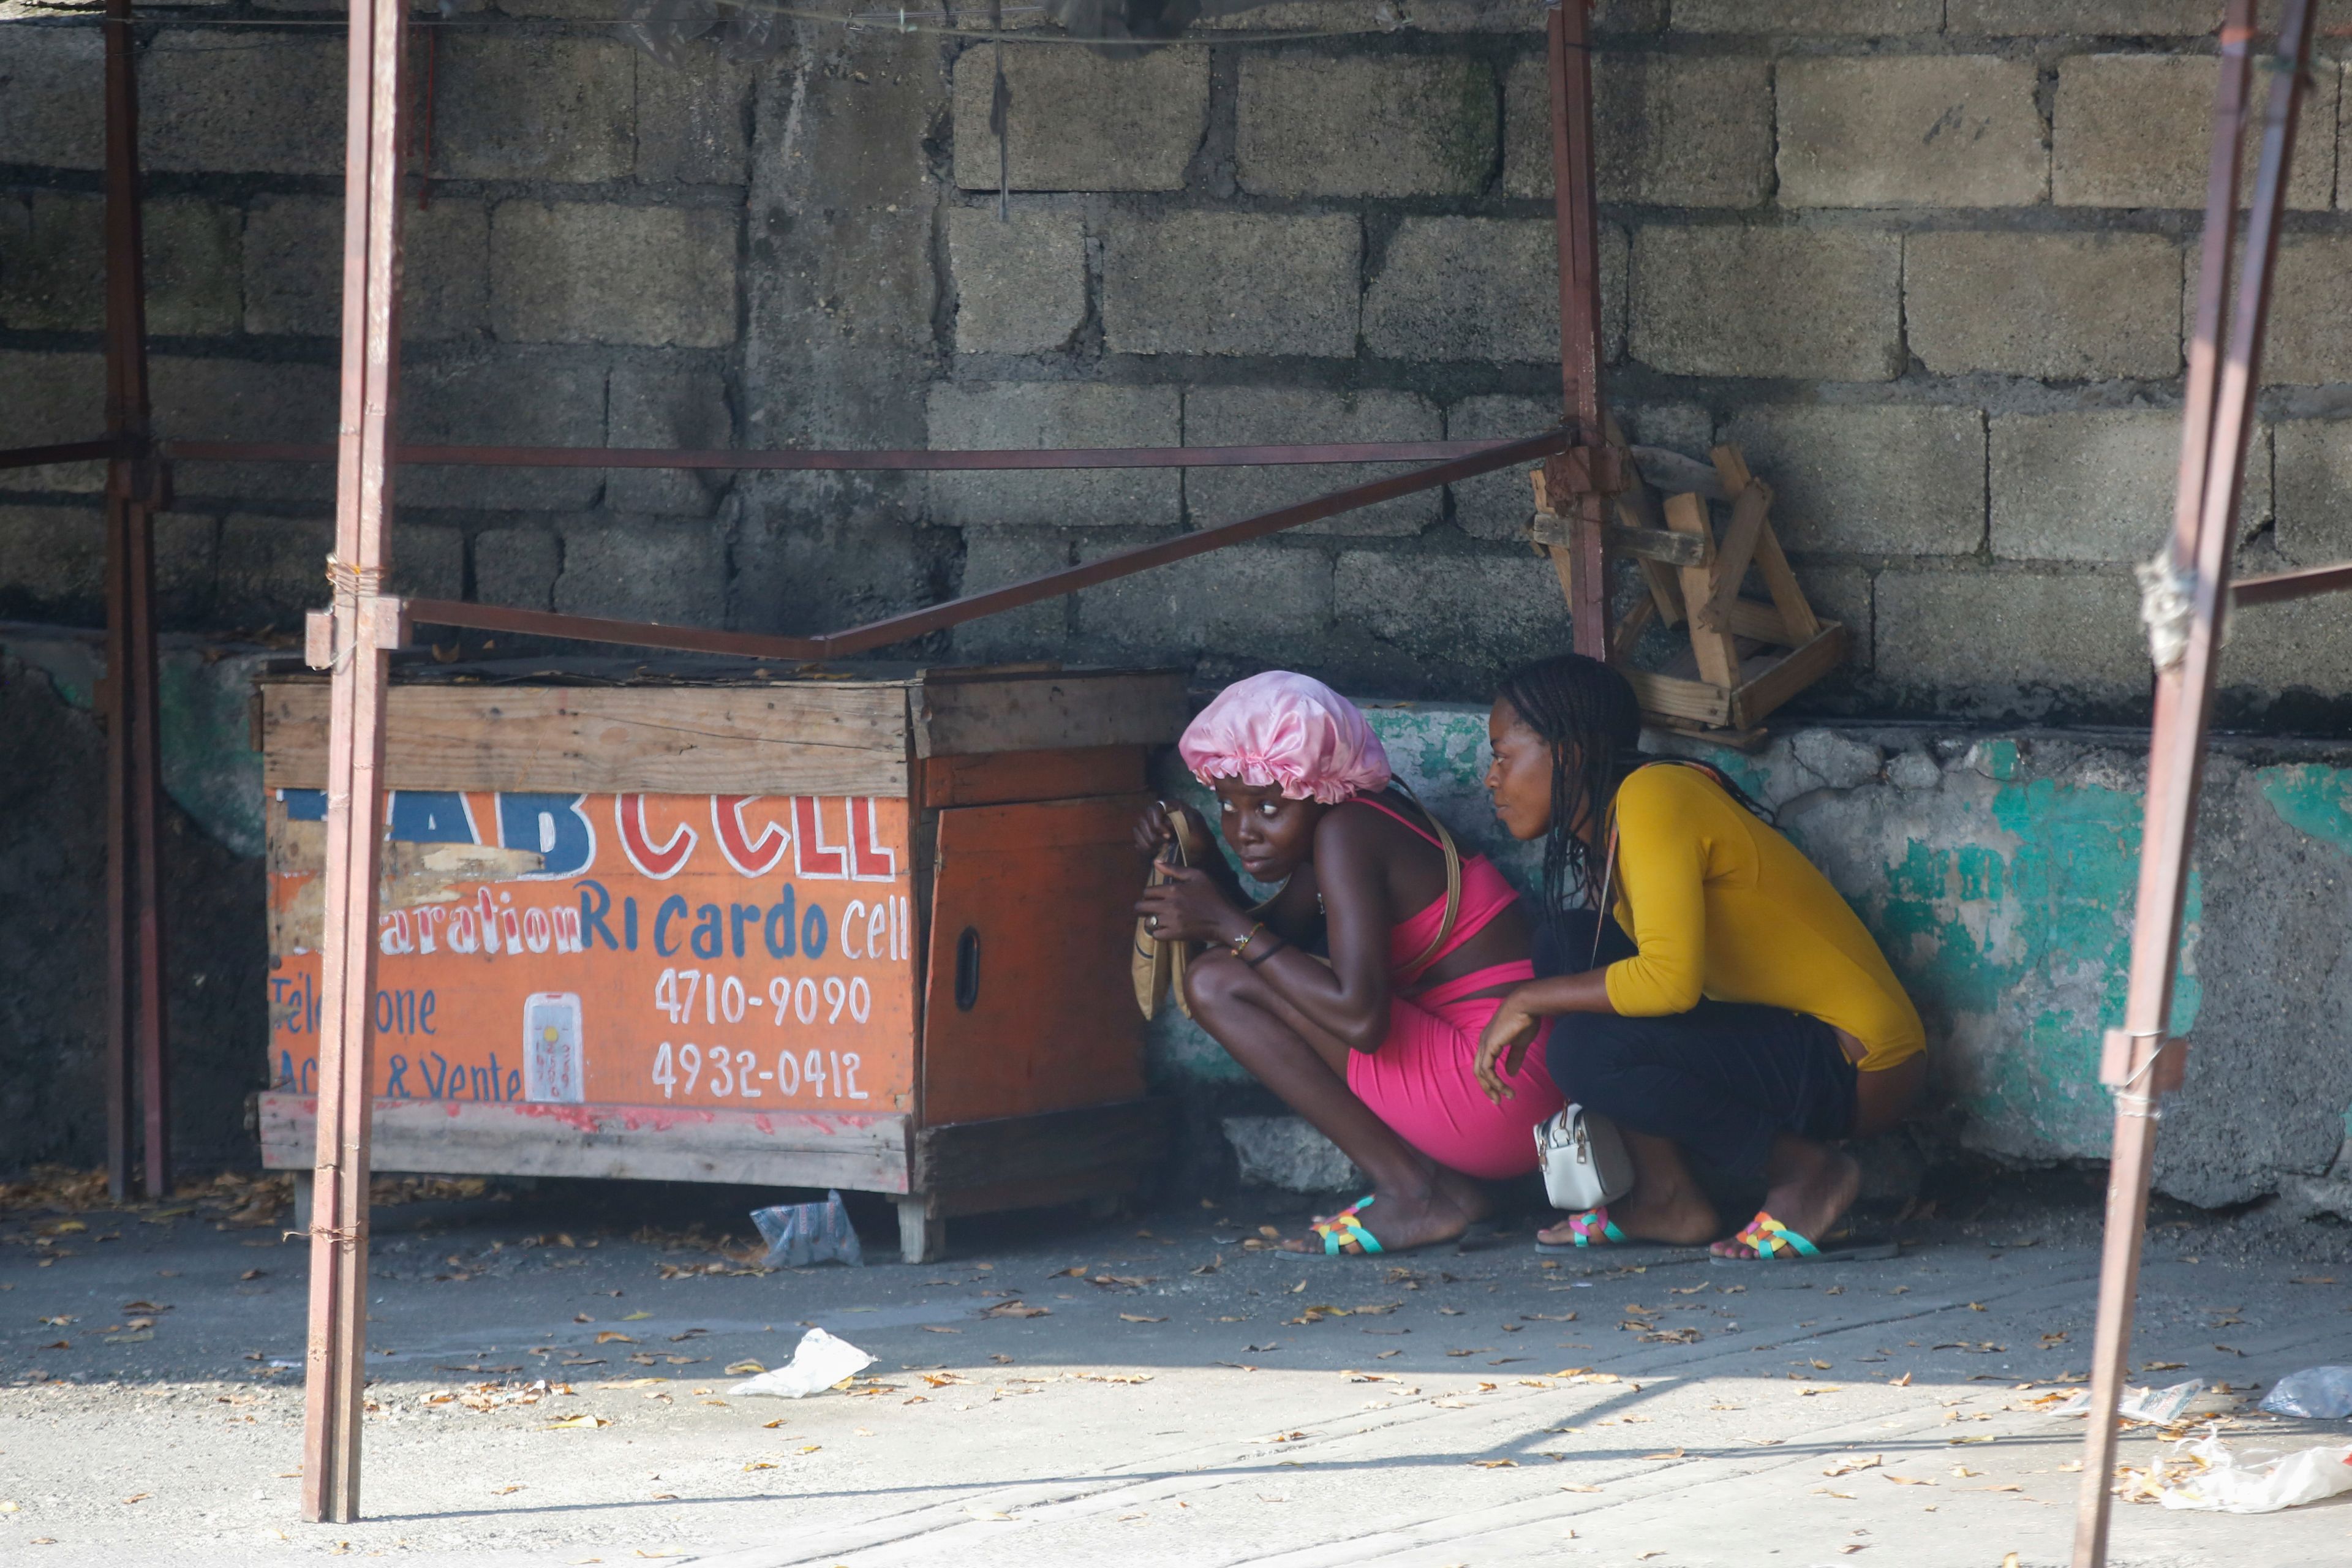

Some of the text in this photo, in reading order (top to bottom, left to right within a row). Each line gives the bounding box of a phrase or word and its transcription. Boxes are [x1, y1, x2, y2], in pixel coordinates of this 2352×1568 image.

[378, 886, 584, 956] aration
[270, 969, 437, 1035] Télone
[655, 968, 871, 1026] 4710-9090
[386, 1054, 411, 1098] &
[419, 1050, 524, 1102] Vente
[652, 1041, 869, 1099] 4932-0412
